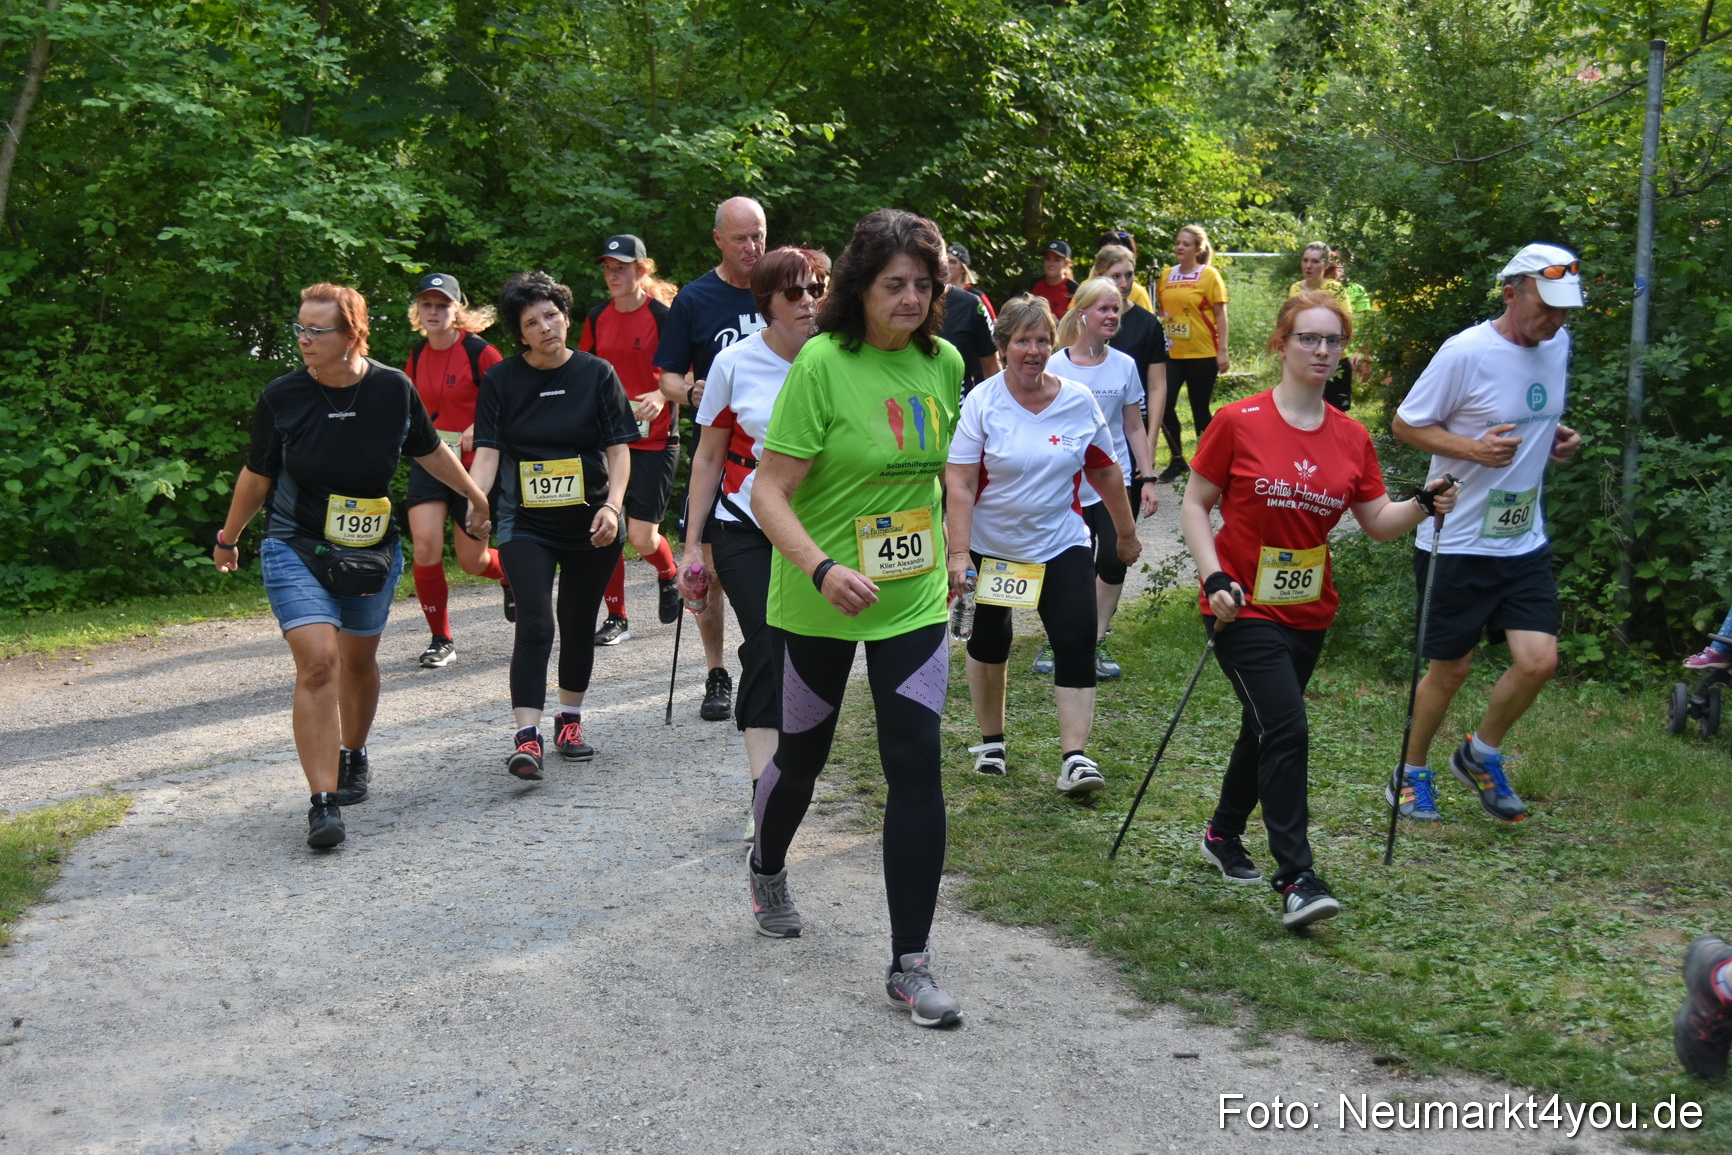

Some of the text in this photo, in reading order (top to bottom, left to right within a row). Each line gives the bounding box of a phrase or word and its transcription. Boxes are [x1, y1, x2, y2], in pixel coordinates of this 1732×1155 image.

[1167, 324, 1187, 333] 1545
[529, 476, 575, 495] 1977
[1254, 478, 1346, 510] Echtes Handwerk
[1267, 498, 1332, 517] IMMER FRISCH
[1498, 506, 1529, 526] 460
[336, 514, 382, 533] 1981
[878, 533, 922, 561] 450
[879, 557, 925, 570] Klier Alexandra
[990, 576, 1028, 595] 360
[1273, 568, 1313, 590] 586
